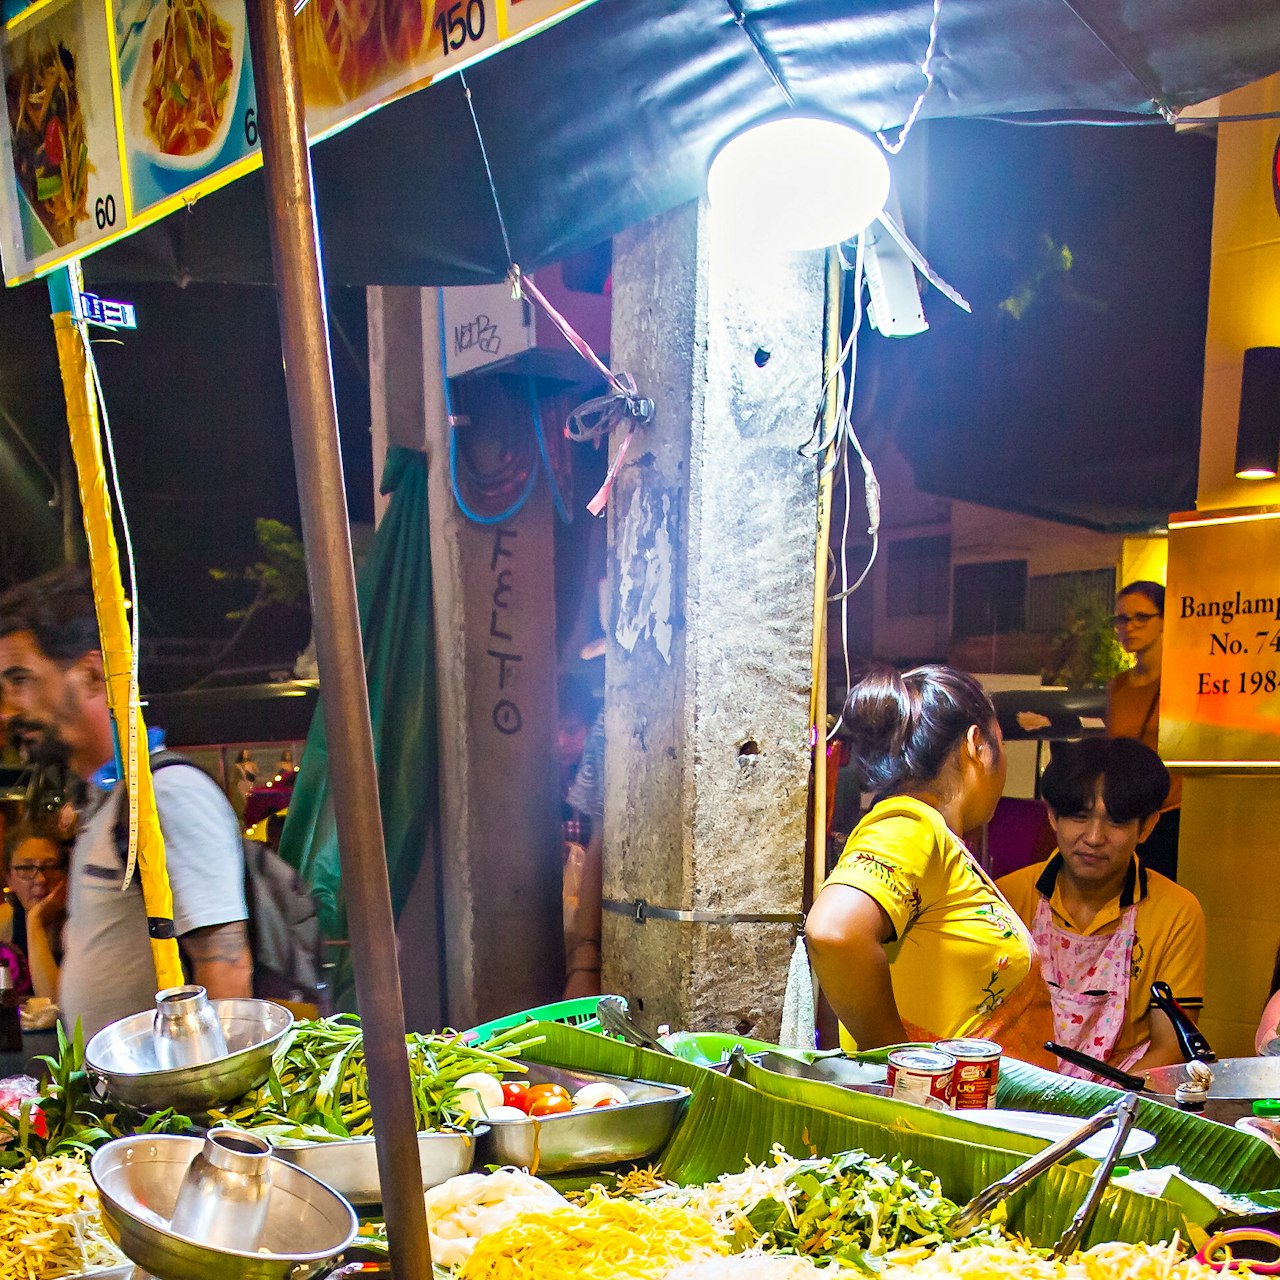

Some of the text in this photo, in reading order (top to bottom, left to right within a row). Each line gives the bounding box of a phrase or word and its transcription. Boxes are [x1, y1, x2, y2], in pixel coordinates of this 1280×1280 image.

[434, 0, 486, 56] 150
[243, 108, 261, 147] 6
[94, 193, 117, 231] 60
[1209, 632, 1249, 656] No.
[1197, 672, 1231, 696] Est
